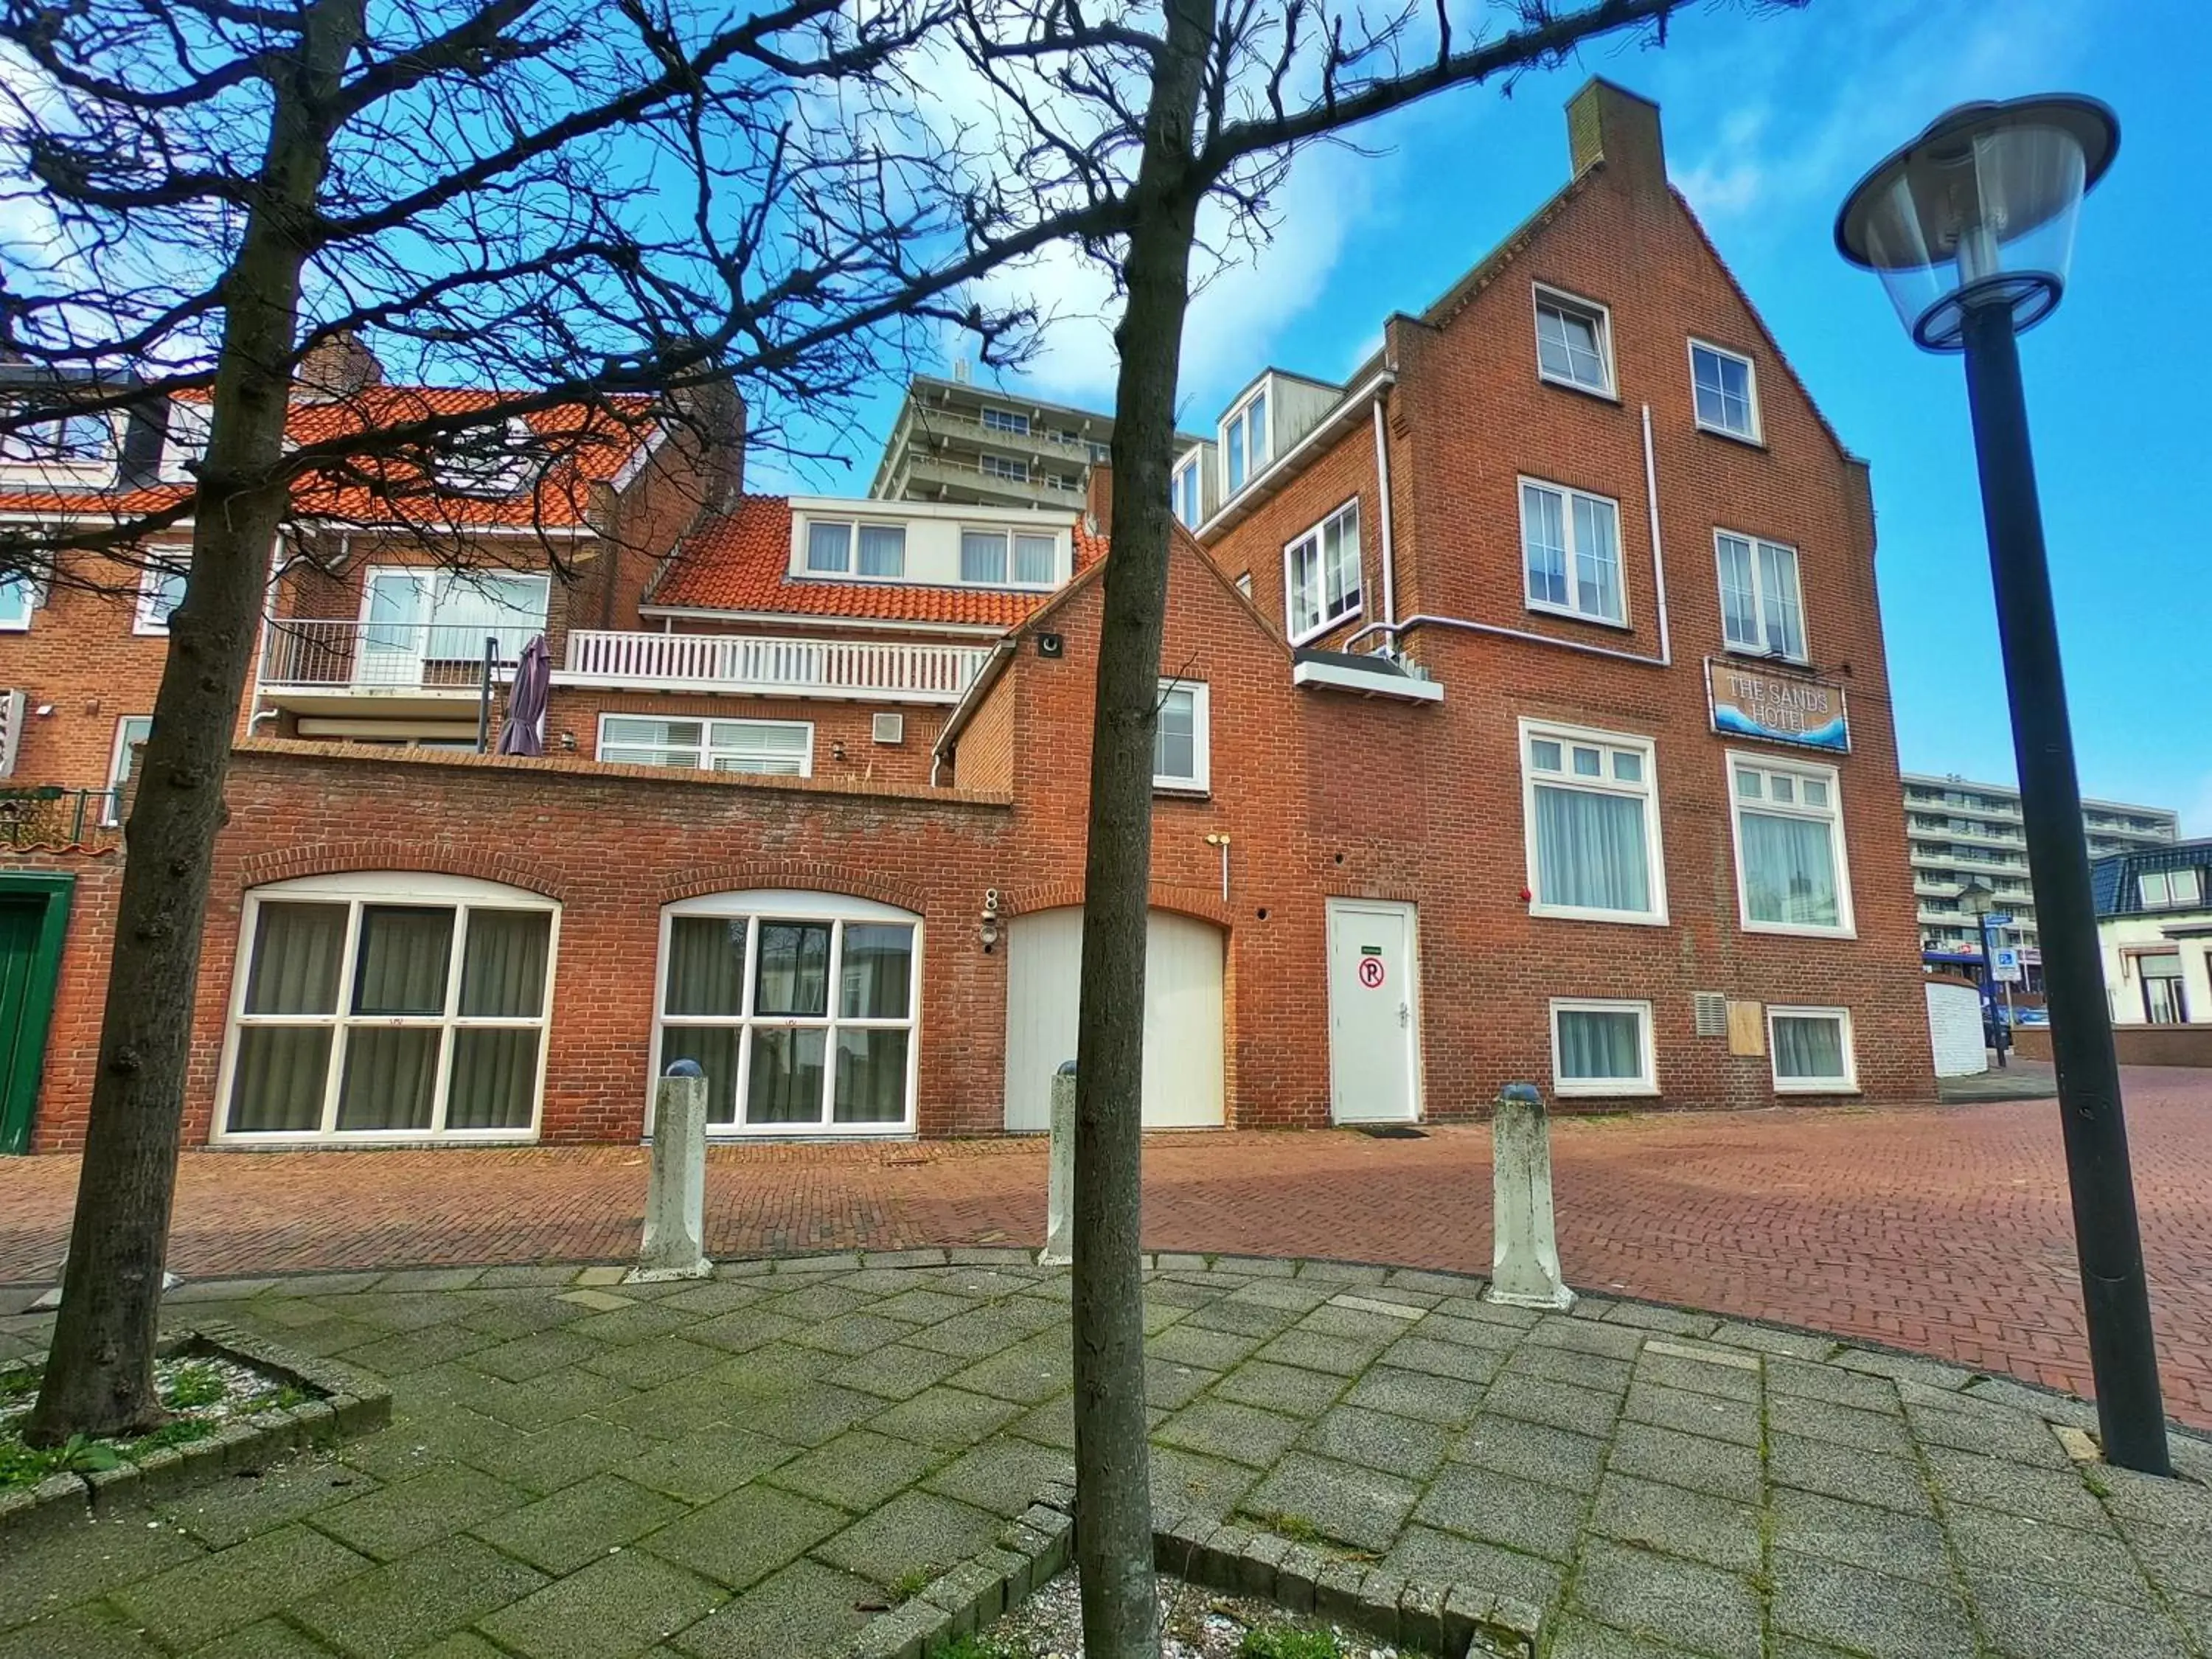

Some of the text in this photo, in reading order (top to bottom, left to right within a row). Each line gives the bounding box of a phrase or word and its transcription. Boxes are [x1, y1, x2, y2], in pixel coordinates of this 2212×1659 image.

[1728, 675, 1829, 714] THE SANDS
[1751, 703, 1808, 733] HOTEL
